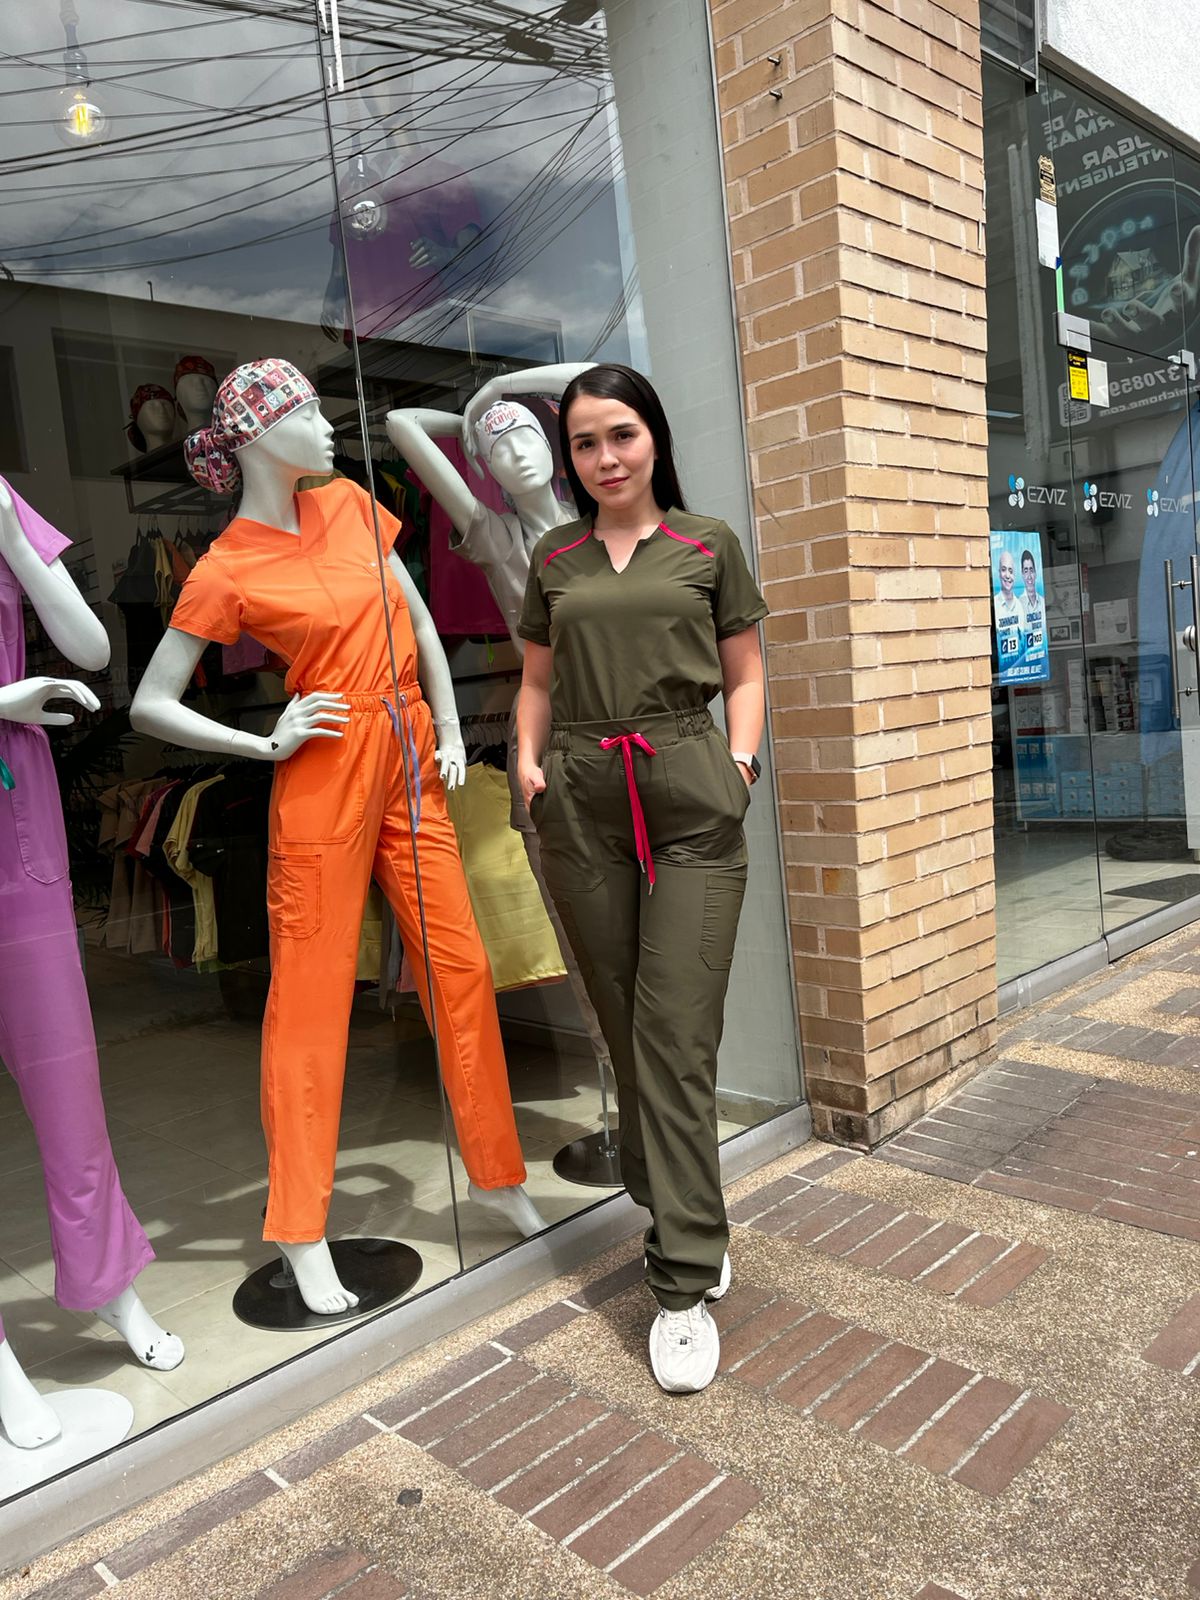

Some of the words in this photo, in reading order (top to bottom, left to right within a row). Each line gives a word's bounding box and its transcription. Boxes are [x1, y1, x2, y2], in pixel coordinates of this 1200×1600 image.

[1027, 486, 1067, 506] EZVIZ
[1100, 491, 1133, 510] EZVIZ
[1160, 497, 1189, 514] EZVIZ
